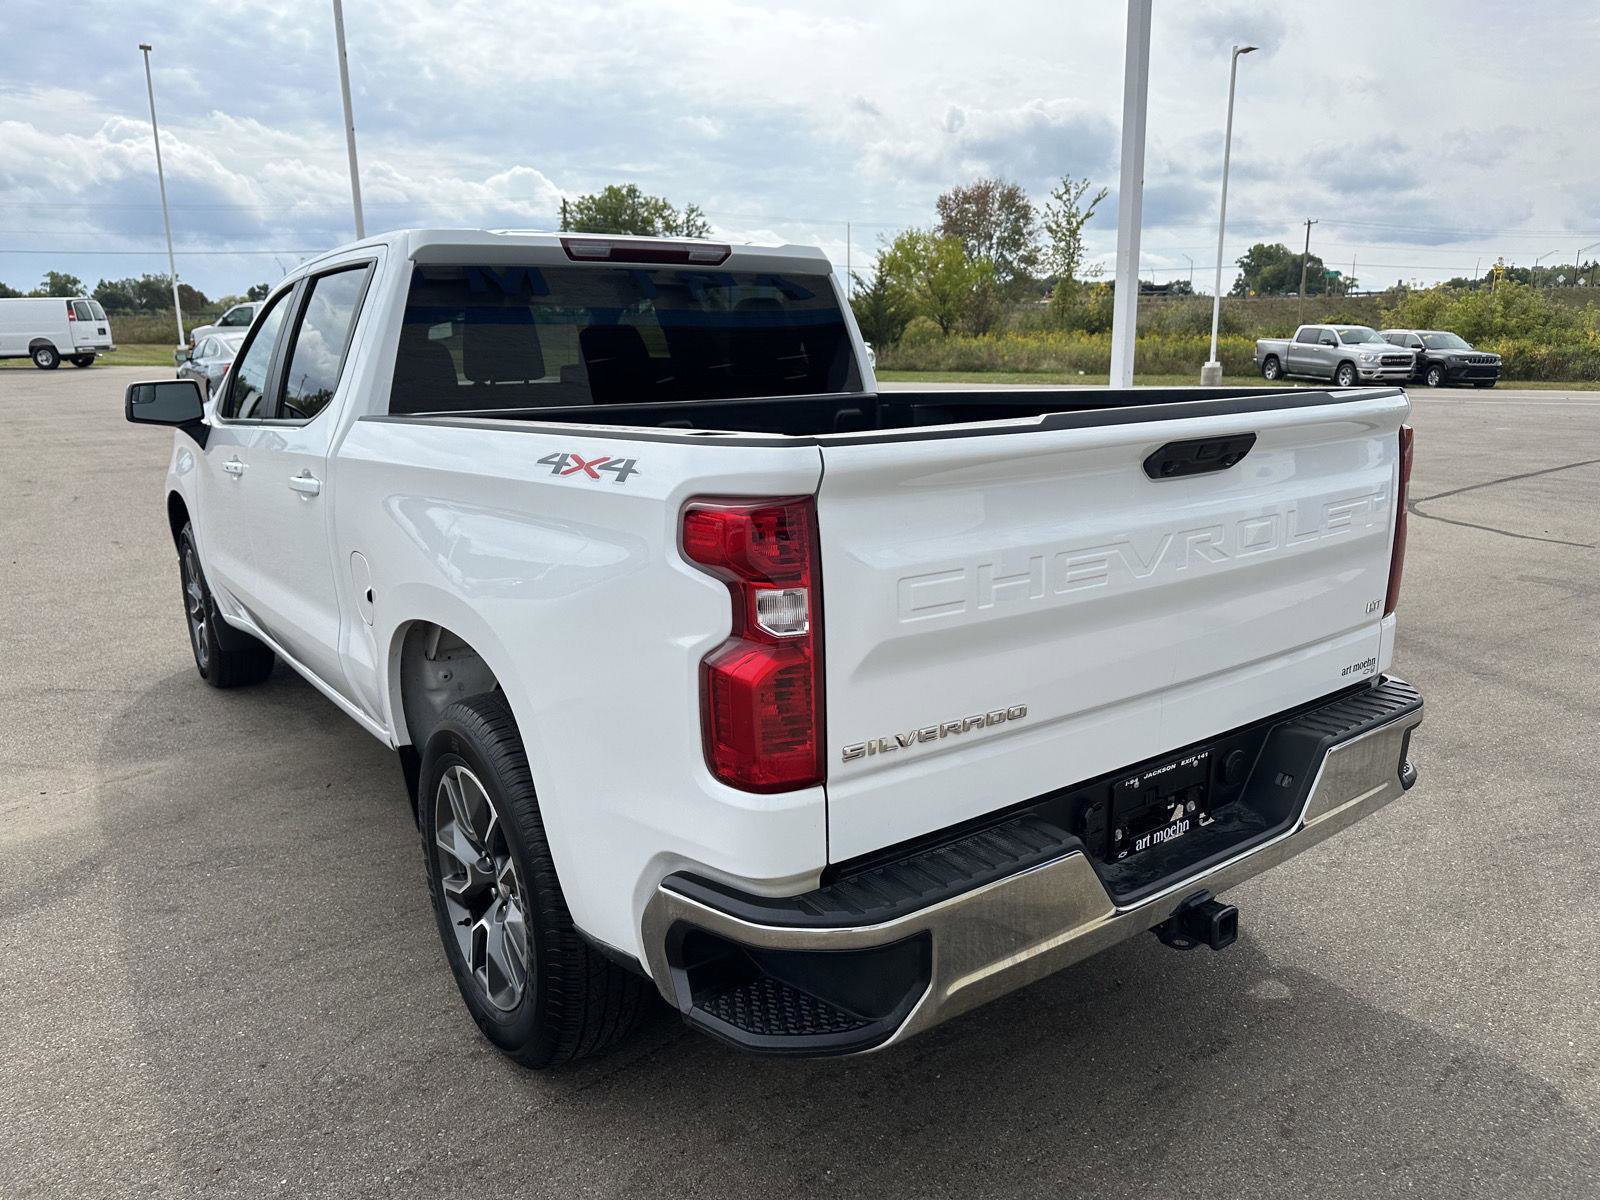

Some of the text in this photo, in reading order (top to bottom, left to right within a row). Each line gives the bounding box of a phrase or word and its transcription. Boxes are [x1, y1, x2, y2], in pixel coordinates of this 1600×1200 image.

[897, 490, 1385, 624] CHEVROLET
[1341, 657, 1376, 677] art moehn
[841, 703, 1028, 764] SILVERADO
[1143, 763, 1177, 780] JACKSON
[1181, 756, 1196, 767] EXIT
[1197, 751, 1209, 760] 141
[1135, 819, 1190, 852] art moehn
